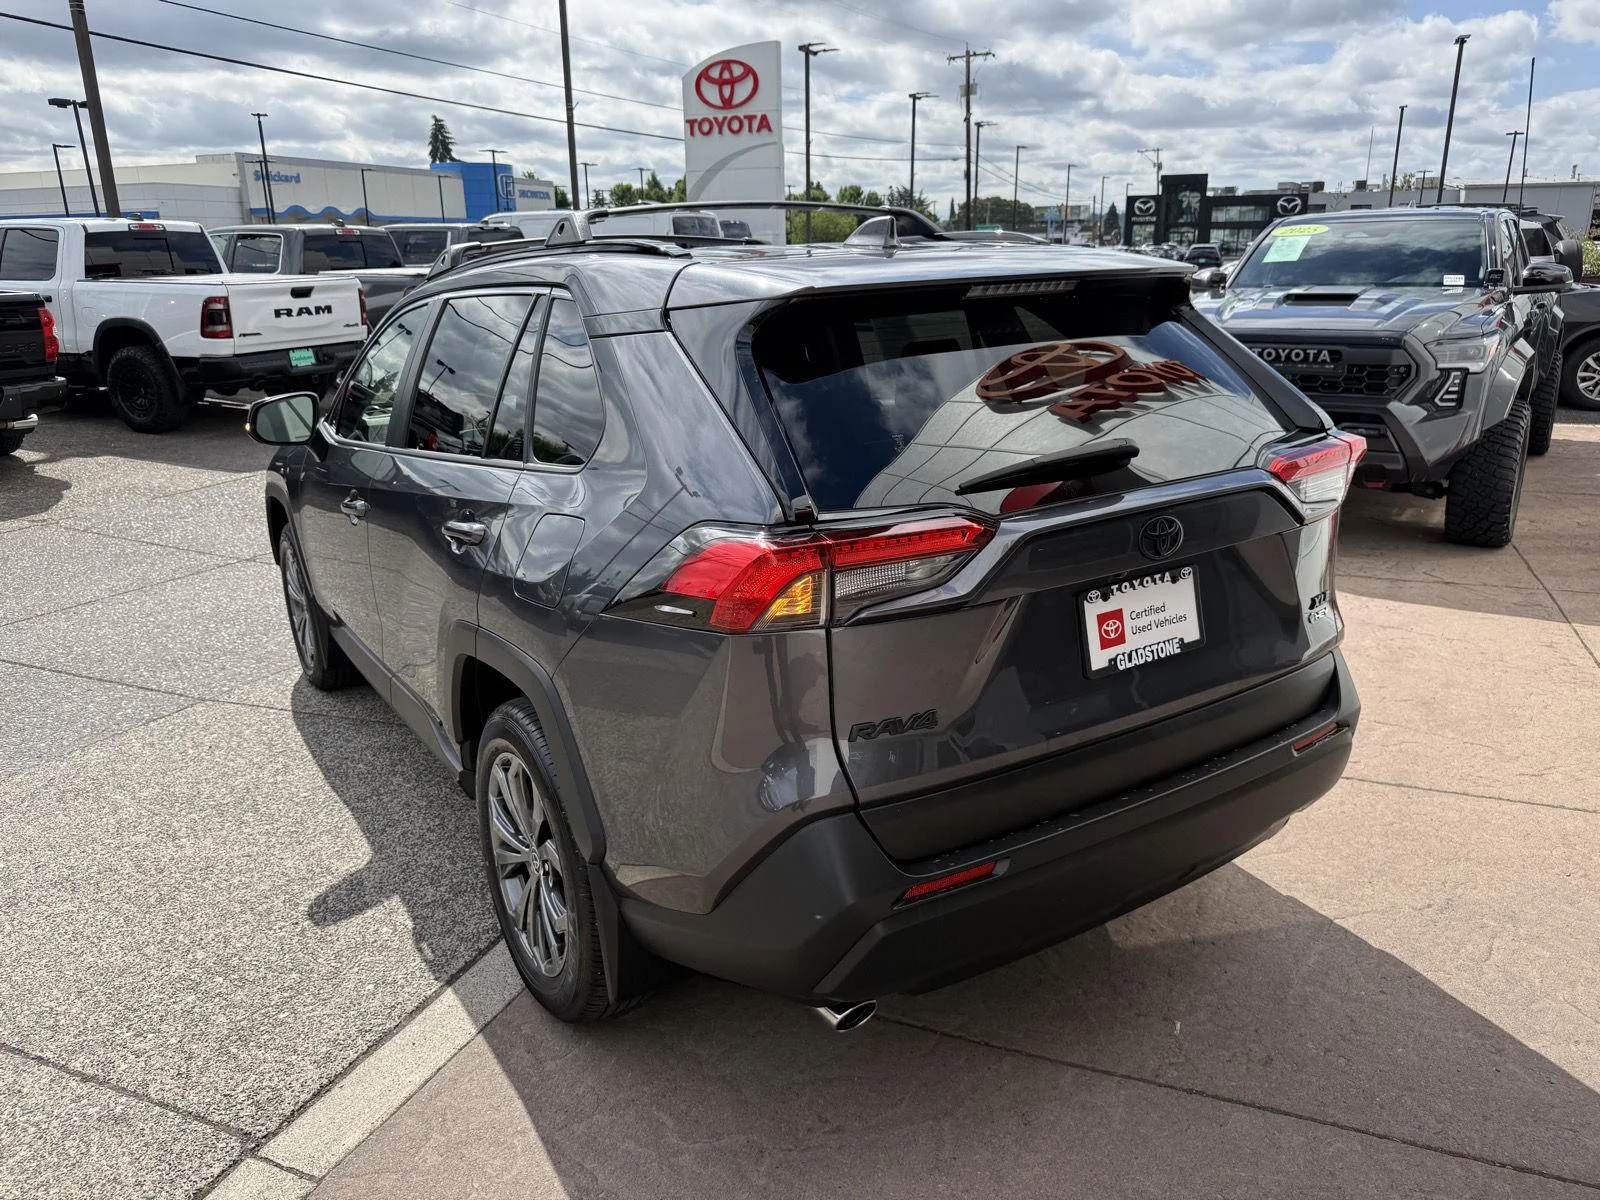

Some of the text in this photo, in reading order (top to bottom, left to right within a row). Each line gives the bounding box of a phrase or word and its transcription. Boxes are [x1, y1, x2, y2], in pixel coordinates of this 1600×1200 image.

[685, 114, 773, 137] TOYOTA
[273, 304, 333, 319] RAM
[1251, 347, 1331, 363] TOYOTA
[1111, 571, 1172, 596] TOYOTA
[1129, 602, 1167, 621] Certified
[1131, 612, 1188, 635] Used Vehicles
[1116, 637, 1182, 671] GLADSTONE
[848, 708, 938, 742] RAV4
